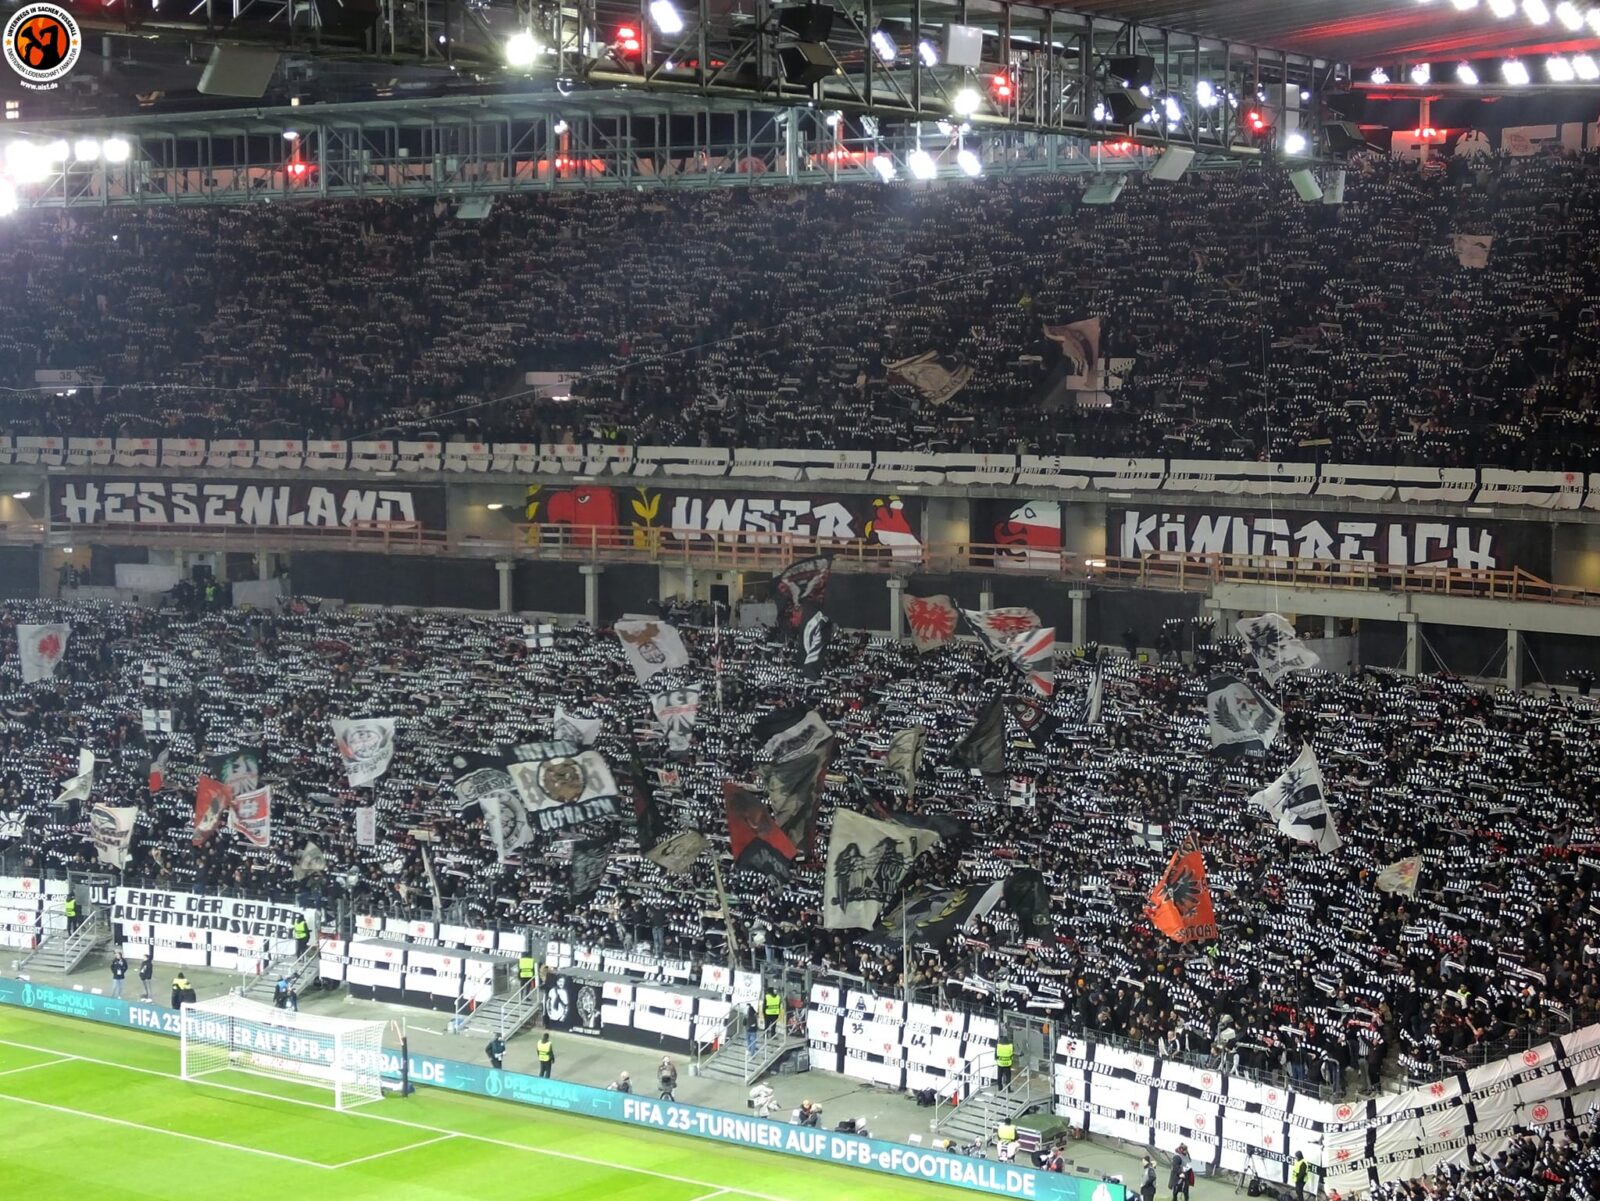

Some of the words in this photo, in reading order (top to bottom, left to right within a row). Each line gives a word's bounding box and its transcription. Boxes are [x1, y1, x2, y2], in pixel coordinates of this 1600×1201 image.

[60, 482, 417, 528] HESSENLAND
[671, 496, 857, 545] UNSER
[1121, 511, 1496, 579] KÖNIGREICH
[128, 890, 176, 909] EHRE
[186, 896, 223, 914] DER
[129, 1006, 161, 1030] FIFA
[255, 1028, 286, 1051] AUF
[852, 1022, 864, 1034] 35
[810, 1040, 838, 1053] FULDA
[1135, 1072, 1167, 1089] REGION
[1520, 1070, 1537, 1082] EFC
[1540, 1064, 1556, 1078] SW
[1424, 1100, 1453, 1114] ELITE
[1462, 1078, 1513, 1104] WETTERAU
[624, 1098, 664, 1125] FIFA
[666, 1106, 782, 1149] 23-TURNIER
[786, 1128, 826, 1155] AUF
[831, 1137, 1036, 1196] DFB-eFOOTBALL.DE
[1392, 1149, 1416, 1162] 1994
[1423, 1126, 1514, 1156] TRADITIONSADLER
